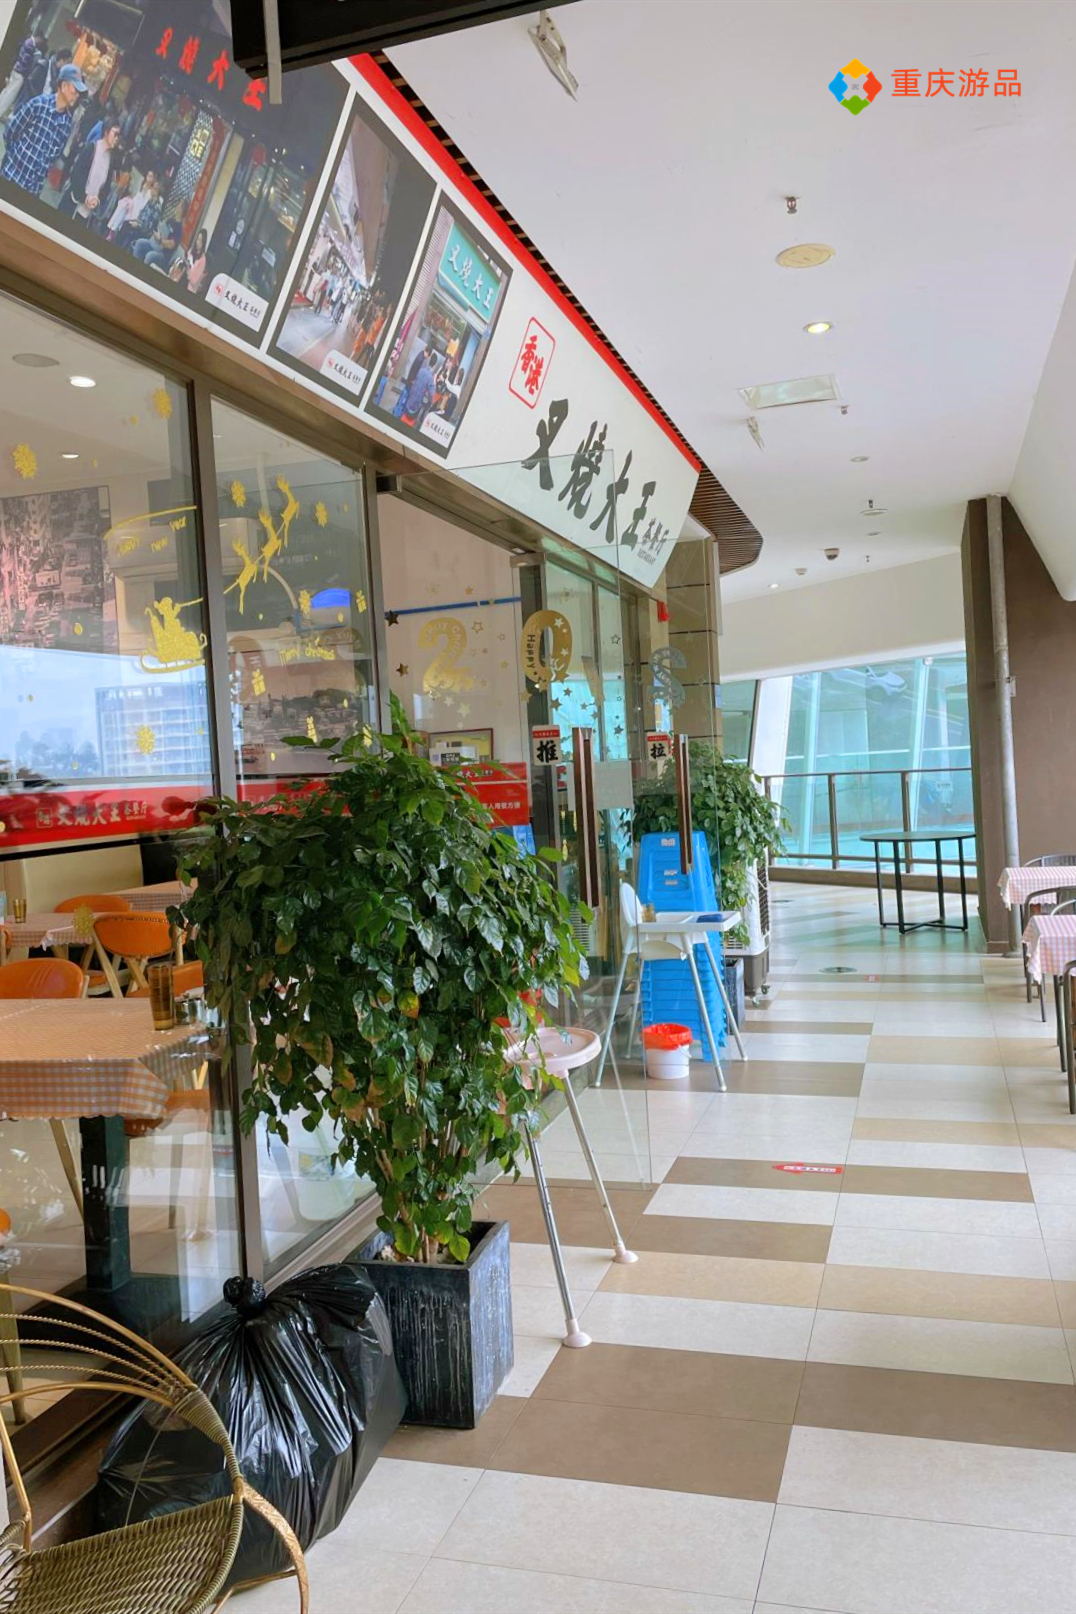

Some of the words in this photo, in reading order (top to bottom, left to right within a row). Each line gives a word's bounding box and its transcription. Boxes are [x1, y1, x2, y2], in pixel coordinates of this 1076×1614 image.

[520, 334, 544, 396] 香港
[526, 633, 536, 669] Happy
[536, 739, 559, 764] 推
[650, 742, 667, 760] 拉
